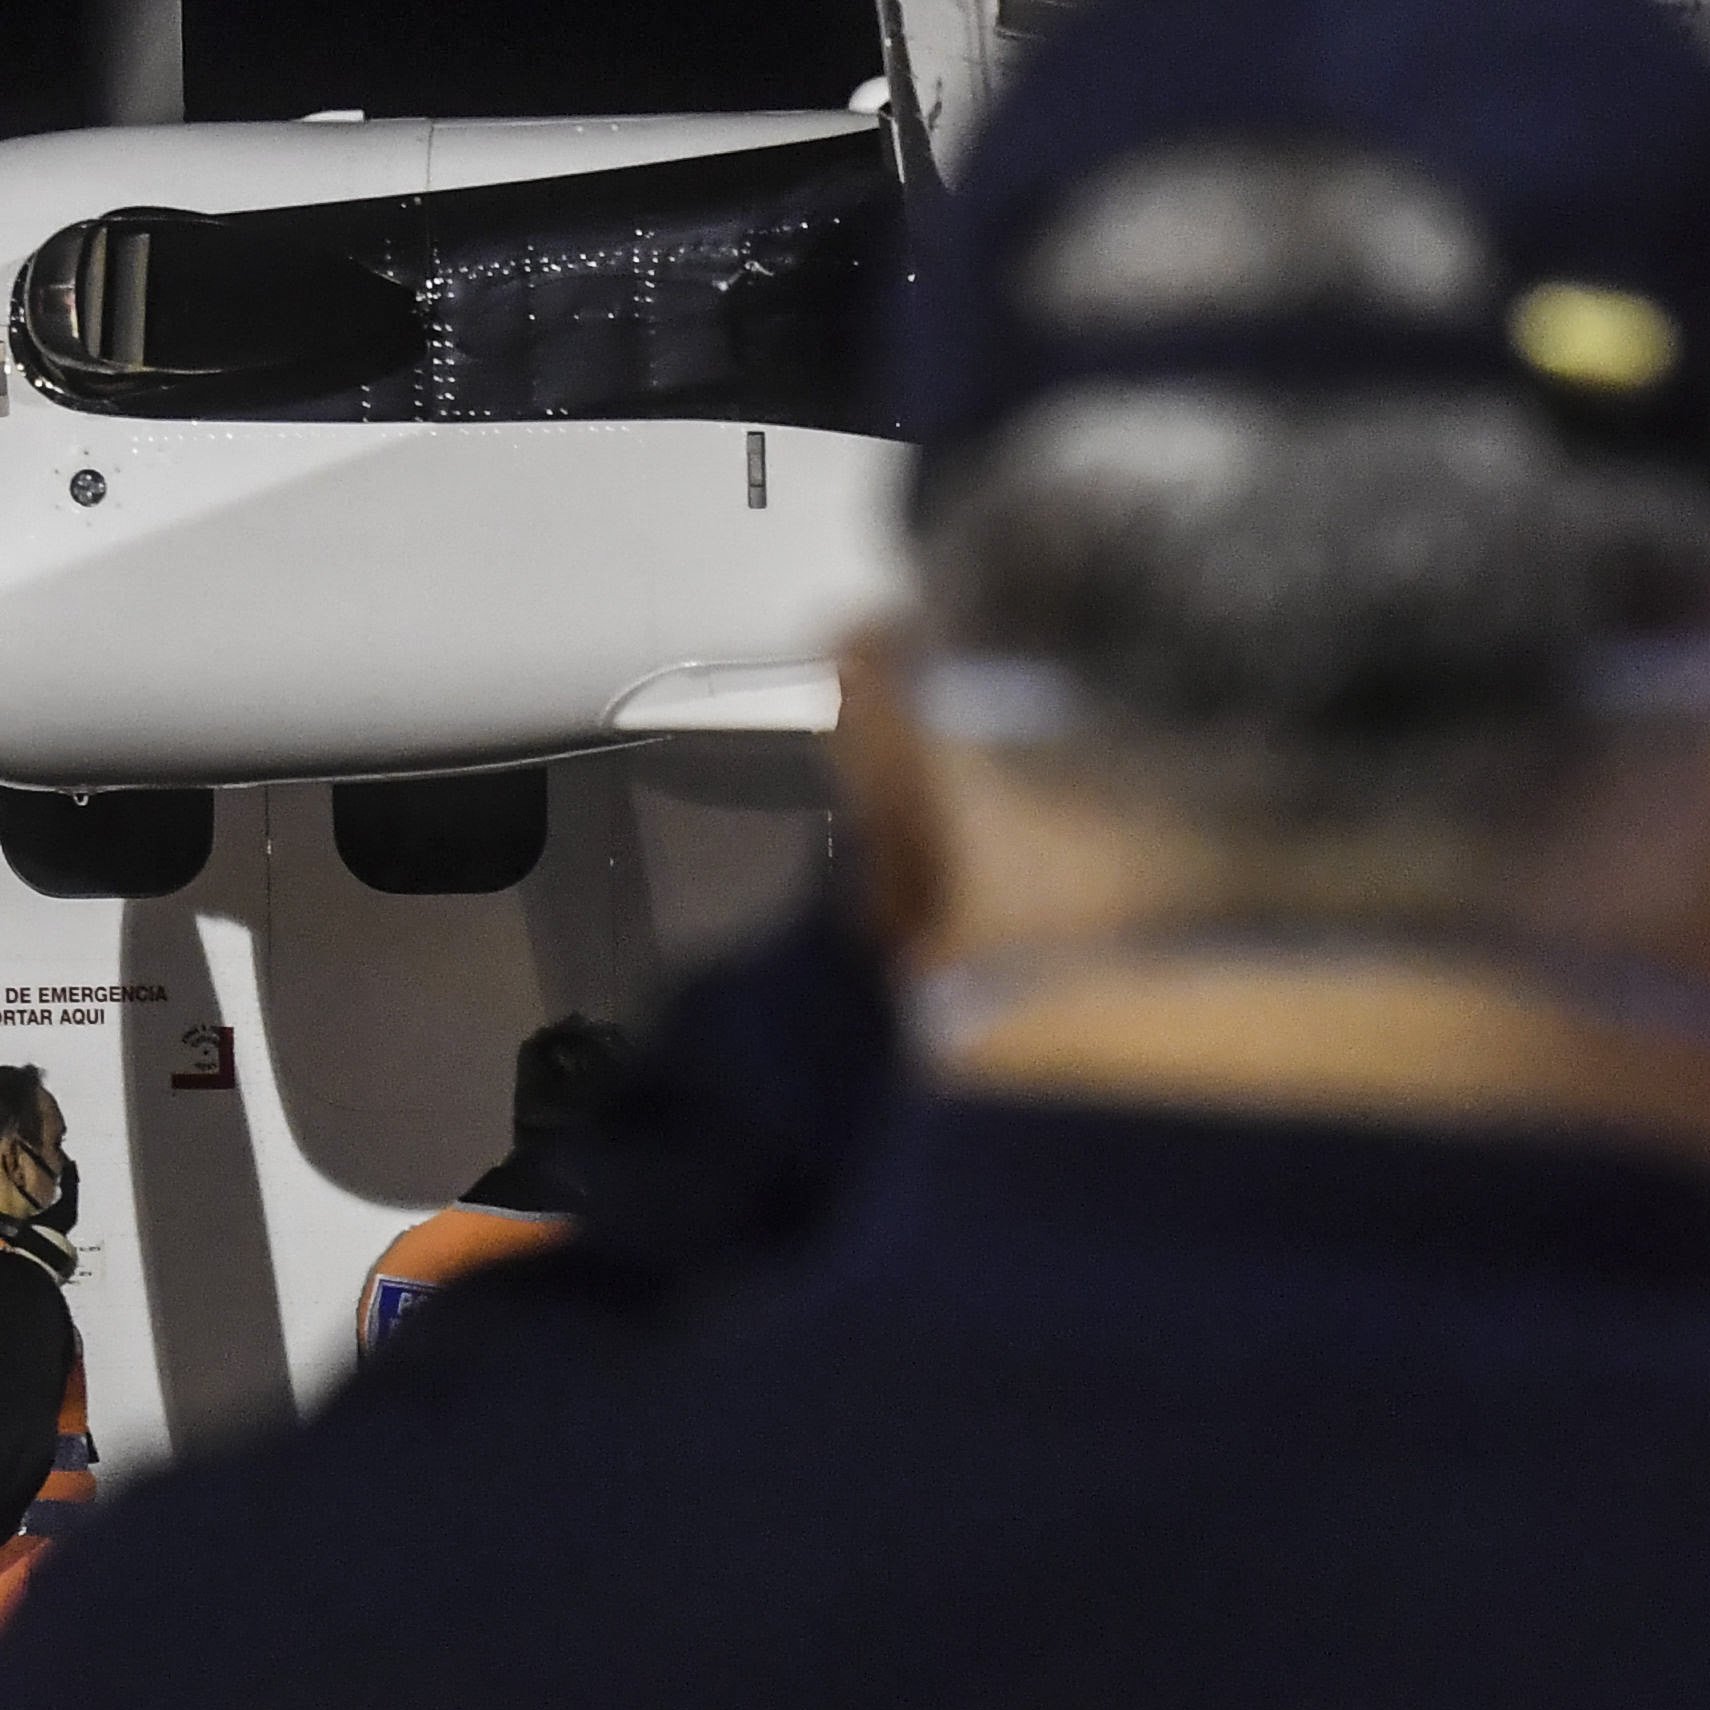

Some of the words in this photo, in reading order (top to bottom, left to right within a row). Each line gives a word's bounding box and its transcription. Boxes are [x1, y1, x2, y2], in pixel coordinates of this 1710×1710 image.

[5, 986, 32, 1004] DE
[37, 984, 169, 1004] EMERGENCIA
[0, 1007, 54, 1026] RTAR
[59, 1007, 106, 1026] AQUI
